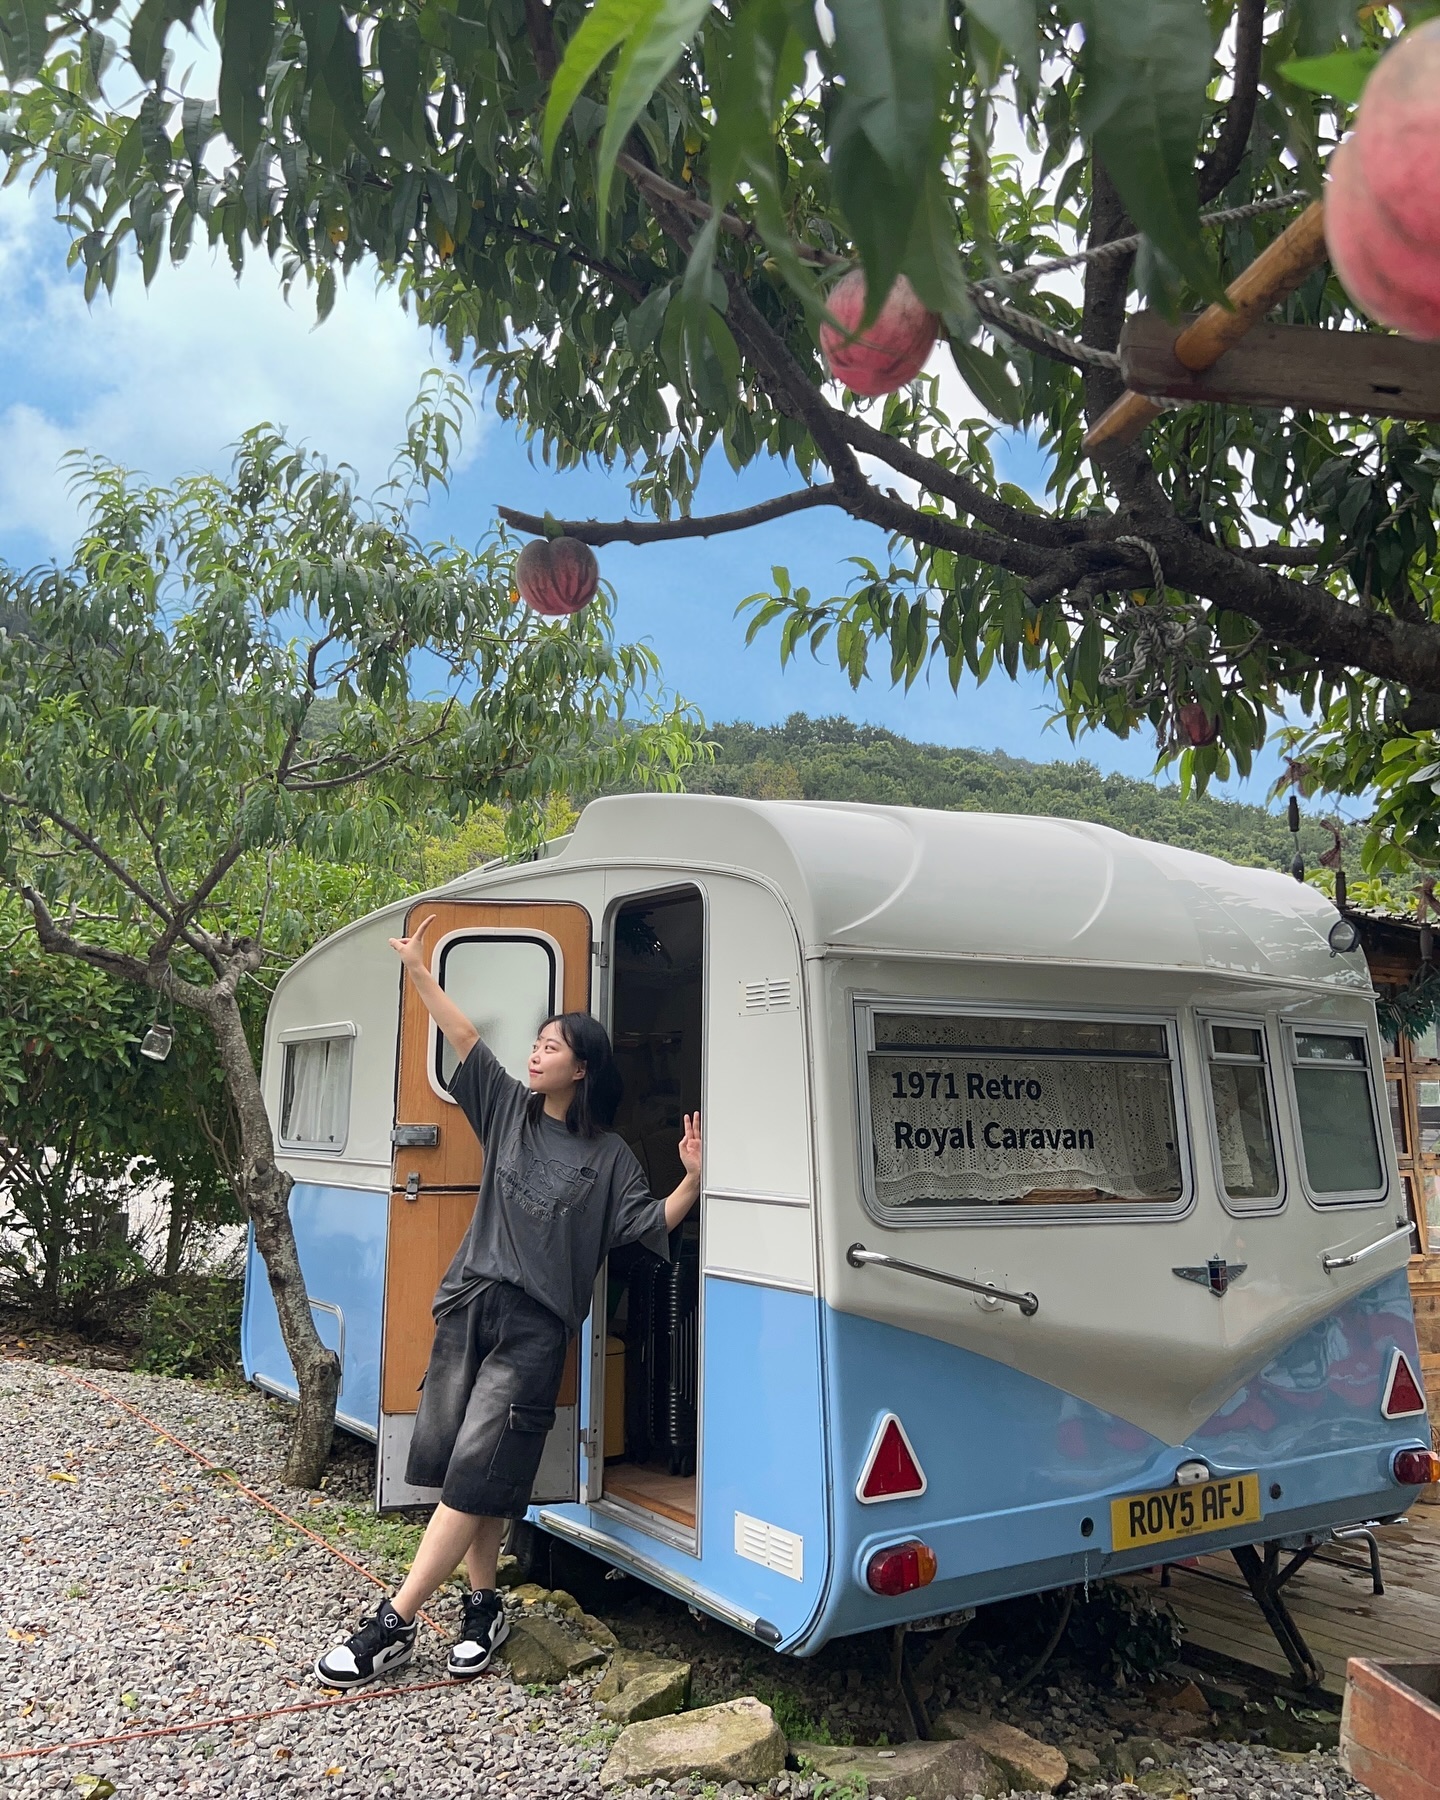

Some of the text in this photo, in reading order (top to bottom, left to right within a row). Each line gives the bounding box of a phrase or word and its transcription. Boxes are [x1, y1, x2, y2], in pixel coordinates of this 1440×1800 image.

[891, 1071, 1042, 1101] 1971 Retro
[893, 1120, 1095, 1157] Royal Caravan
[1129, 1481, 1244, 1538] ROY5 AFJ
